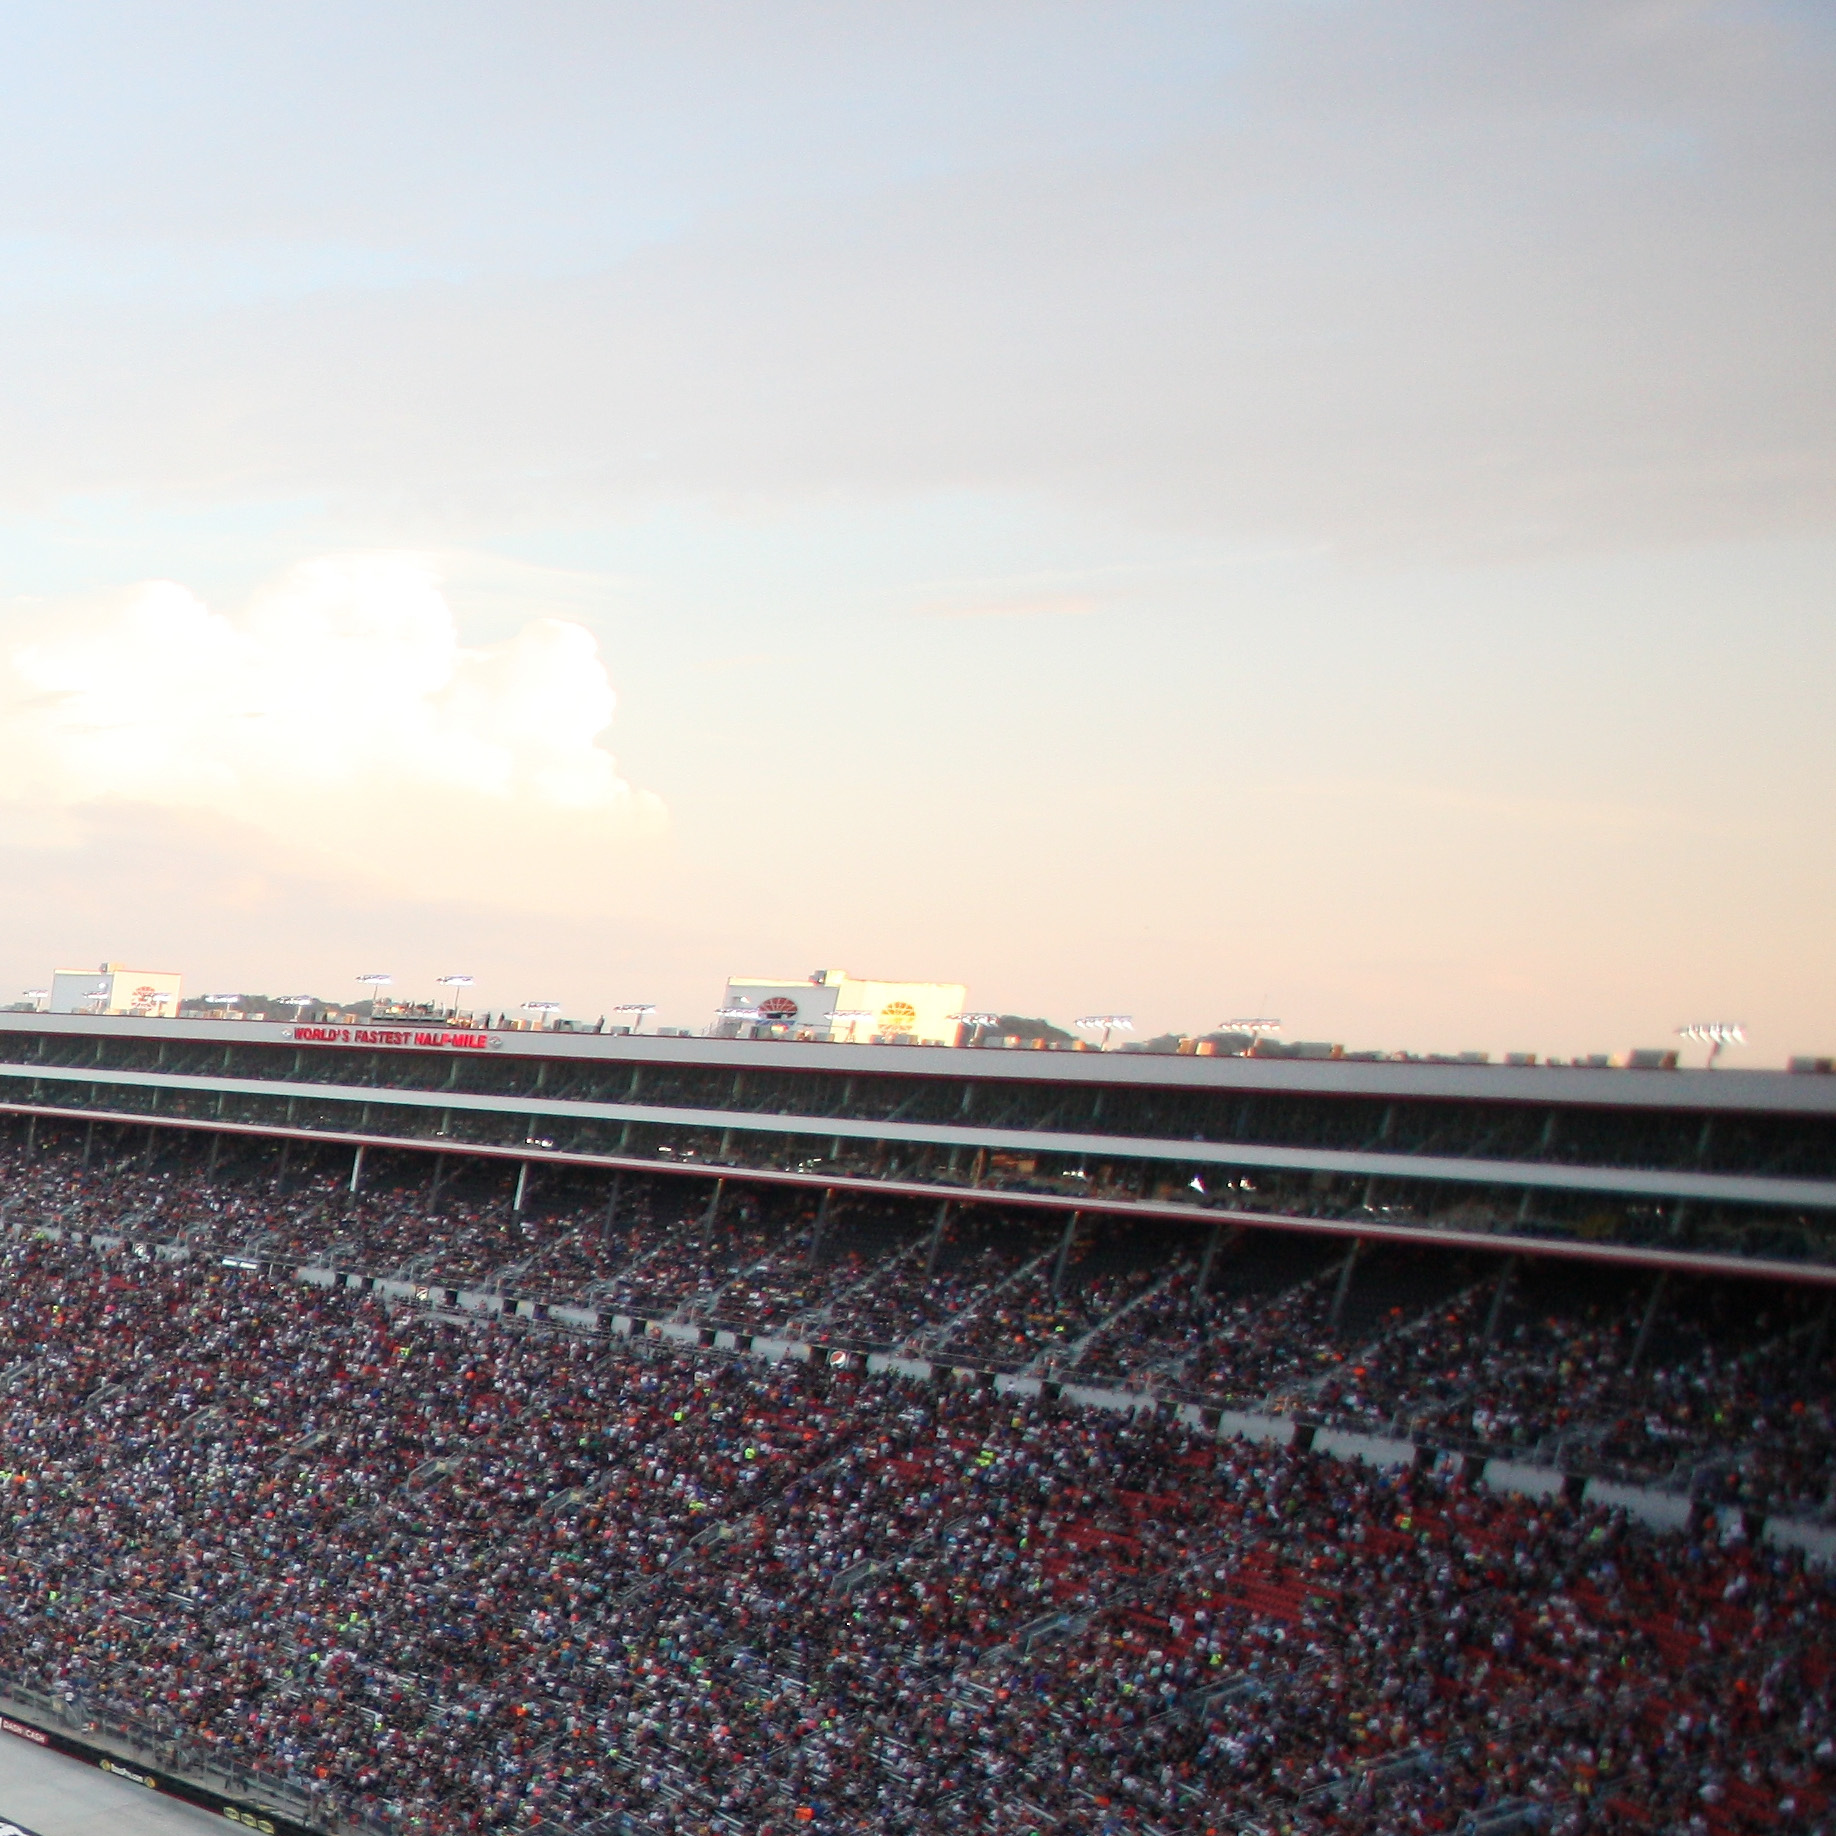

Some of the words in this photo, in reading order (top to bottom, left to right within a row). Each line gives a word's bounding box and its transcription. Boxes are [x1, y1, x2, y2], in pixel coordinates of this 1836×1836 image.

[294, 1027, 349, 1042] WORLD'S
[354, 1030, 411, 1044] FASTEST
[414, 1033, 487, 1048] HALF-MILE
